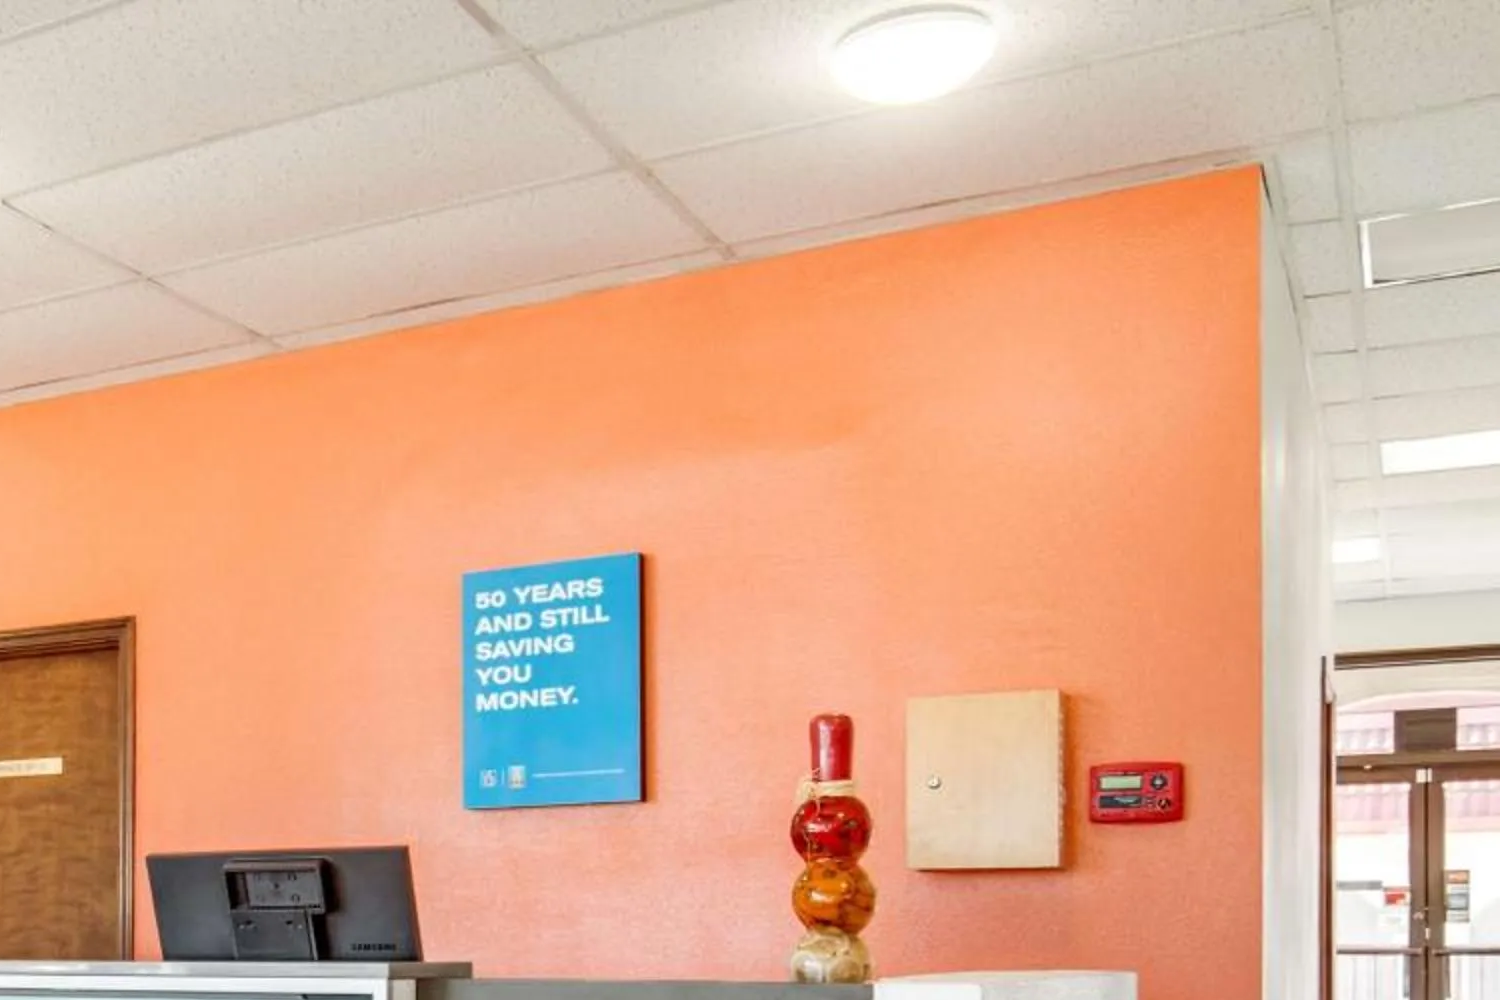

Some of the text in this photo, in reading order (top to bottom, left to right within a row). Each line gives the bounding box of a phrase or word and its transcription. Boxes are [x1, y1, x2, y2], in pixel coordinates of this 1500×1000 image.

[475, 578, 605, 609] 50 YEARS
[475, 605, 610, 635] AND STILL
[475, 634, 575, 661] SAVING
[475, 664, 532, 686] YOU
[475, 686, 579, 712] MONEY.
